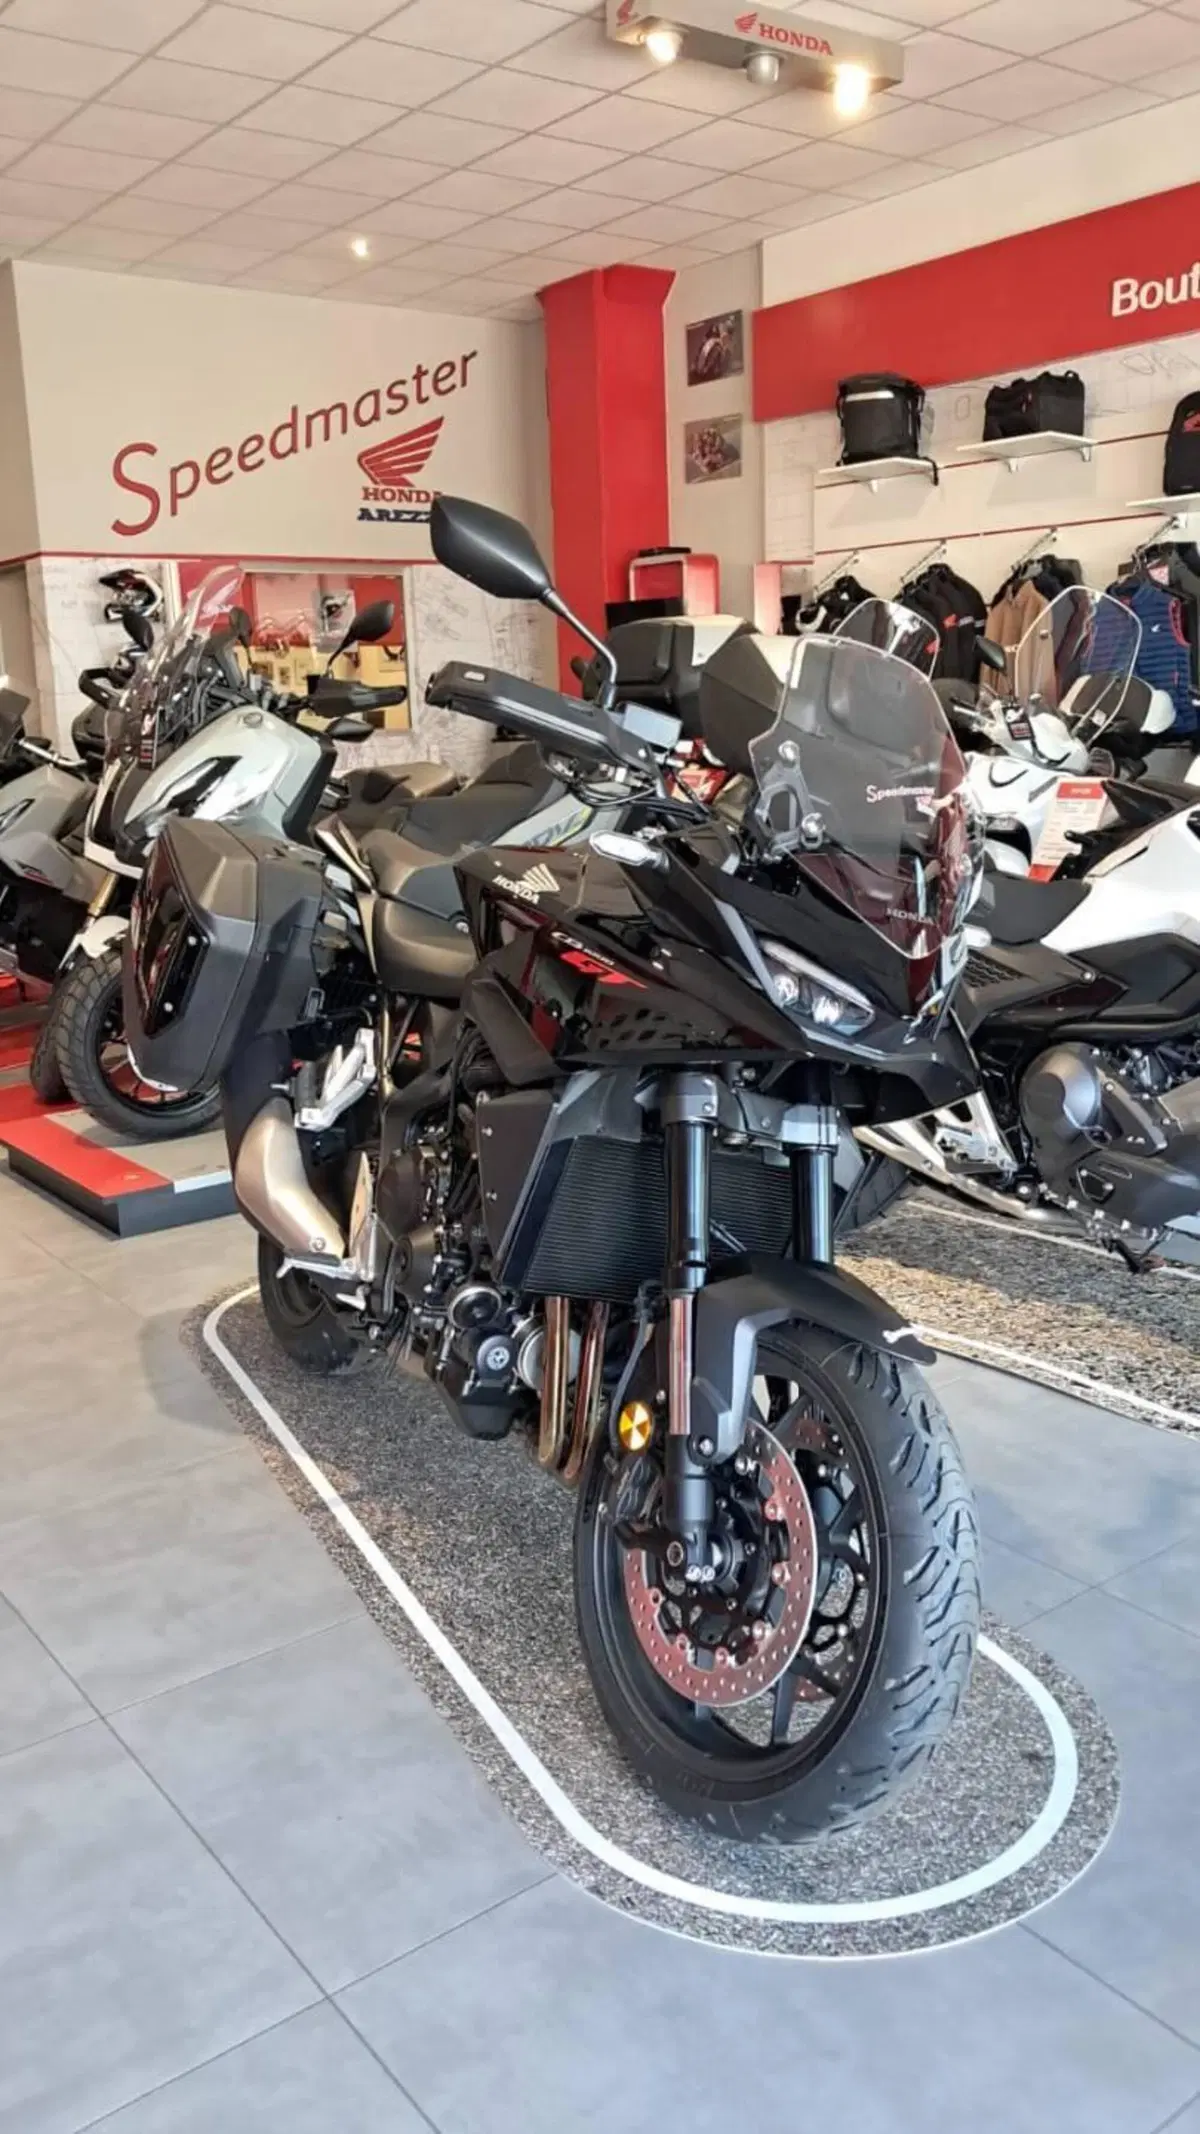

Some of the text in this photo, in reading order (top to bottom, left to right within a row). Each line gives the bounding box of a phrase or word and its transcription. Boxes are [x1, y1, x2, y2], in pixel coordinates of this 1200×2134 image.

[758, 22, 834, 56] HONDA
[1111, 260, 1200, 318] Bout
[111, 349, 478, 536] Speedmaster
[492, 875, 541, 905] HONDA
